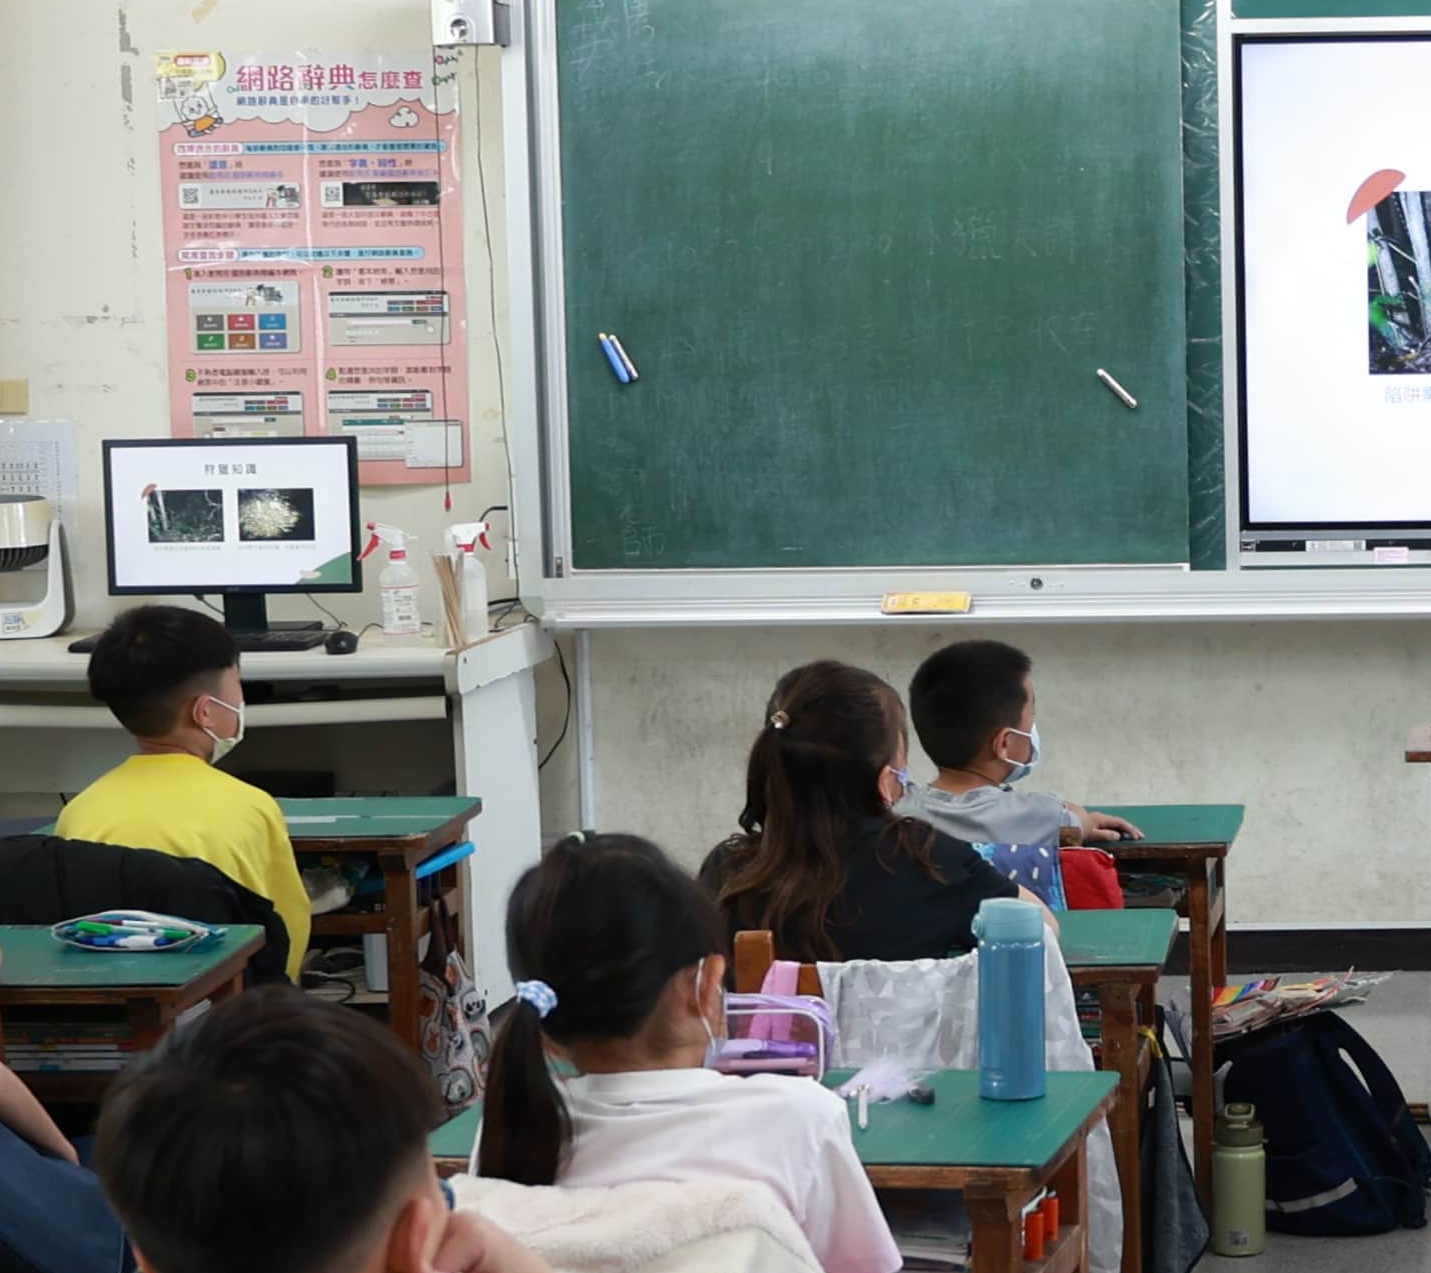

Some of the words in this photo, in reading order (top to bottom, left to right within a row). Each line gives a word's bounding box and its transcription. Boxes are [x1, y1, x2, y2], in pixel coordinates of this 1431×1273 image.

[235, 63, 425, 92] 網路辭典怎麼查
